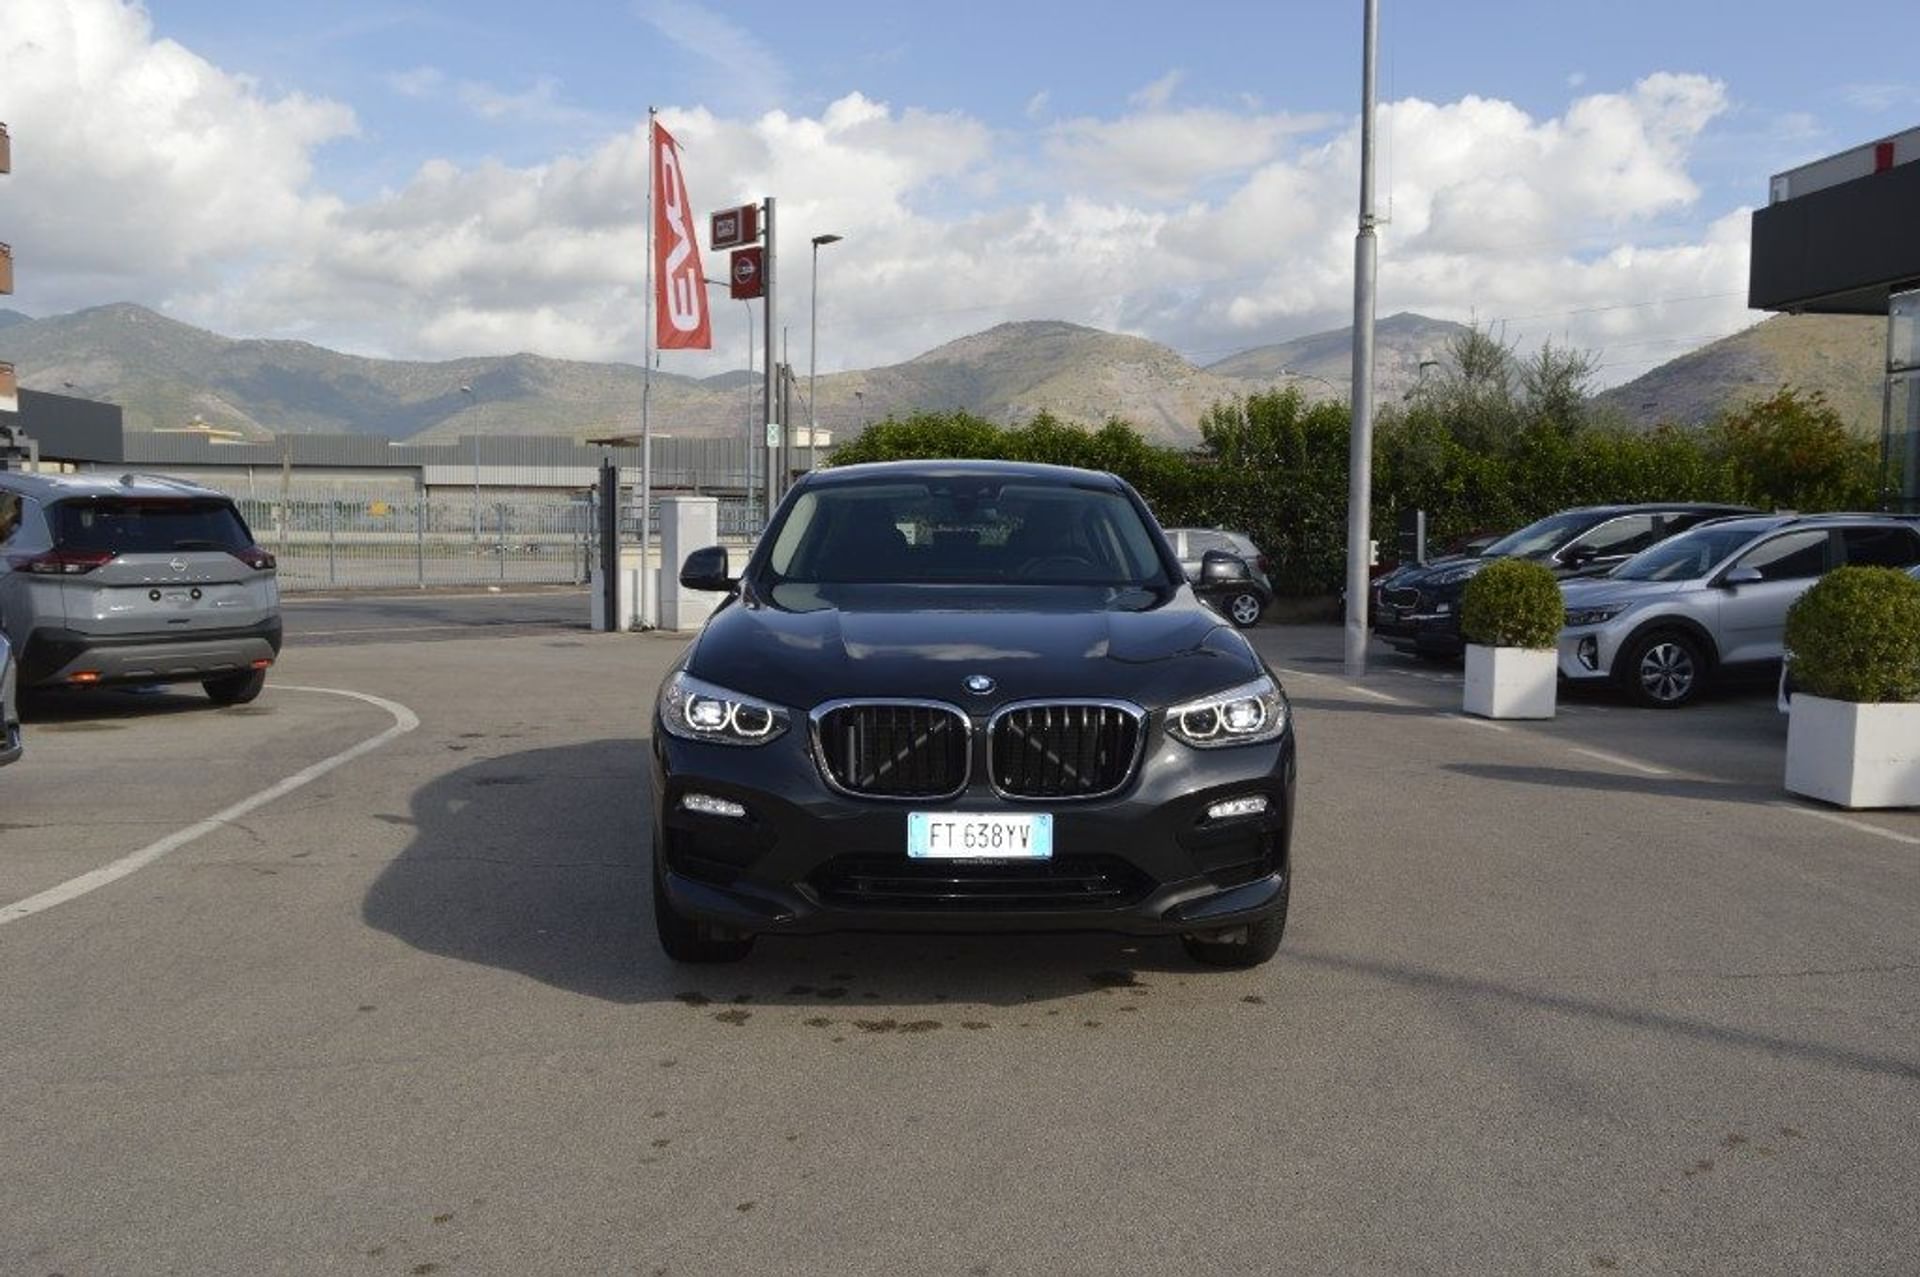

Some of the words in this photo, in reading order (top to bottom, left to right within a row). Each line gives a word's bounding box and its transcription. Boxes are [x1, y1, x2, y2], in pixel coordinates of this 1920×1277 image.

[661, 143, 700, 332] EVO
[930, 823, 956, 848] FT
[964, 823, 1031, 848] 638YV
